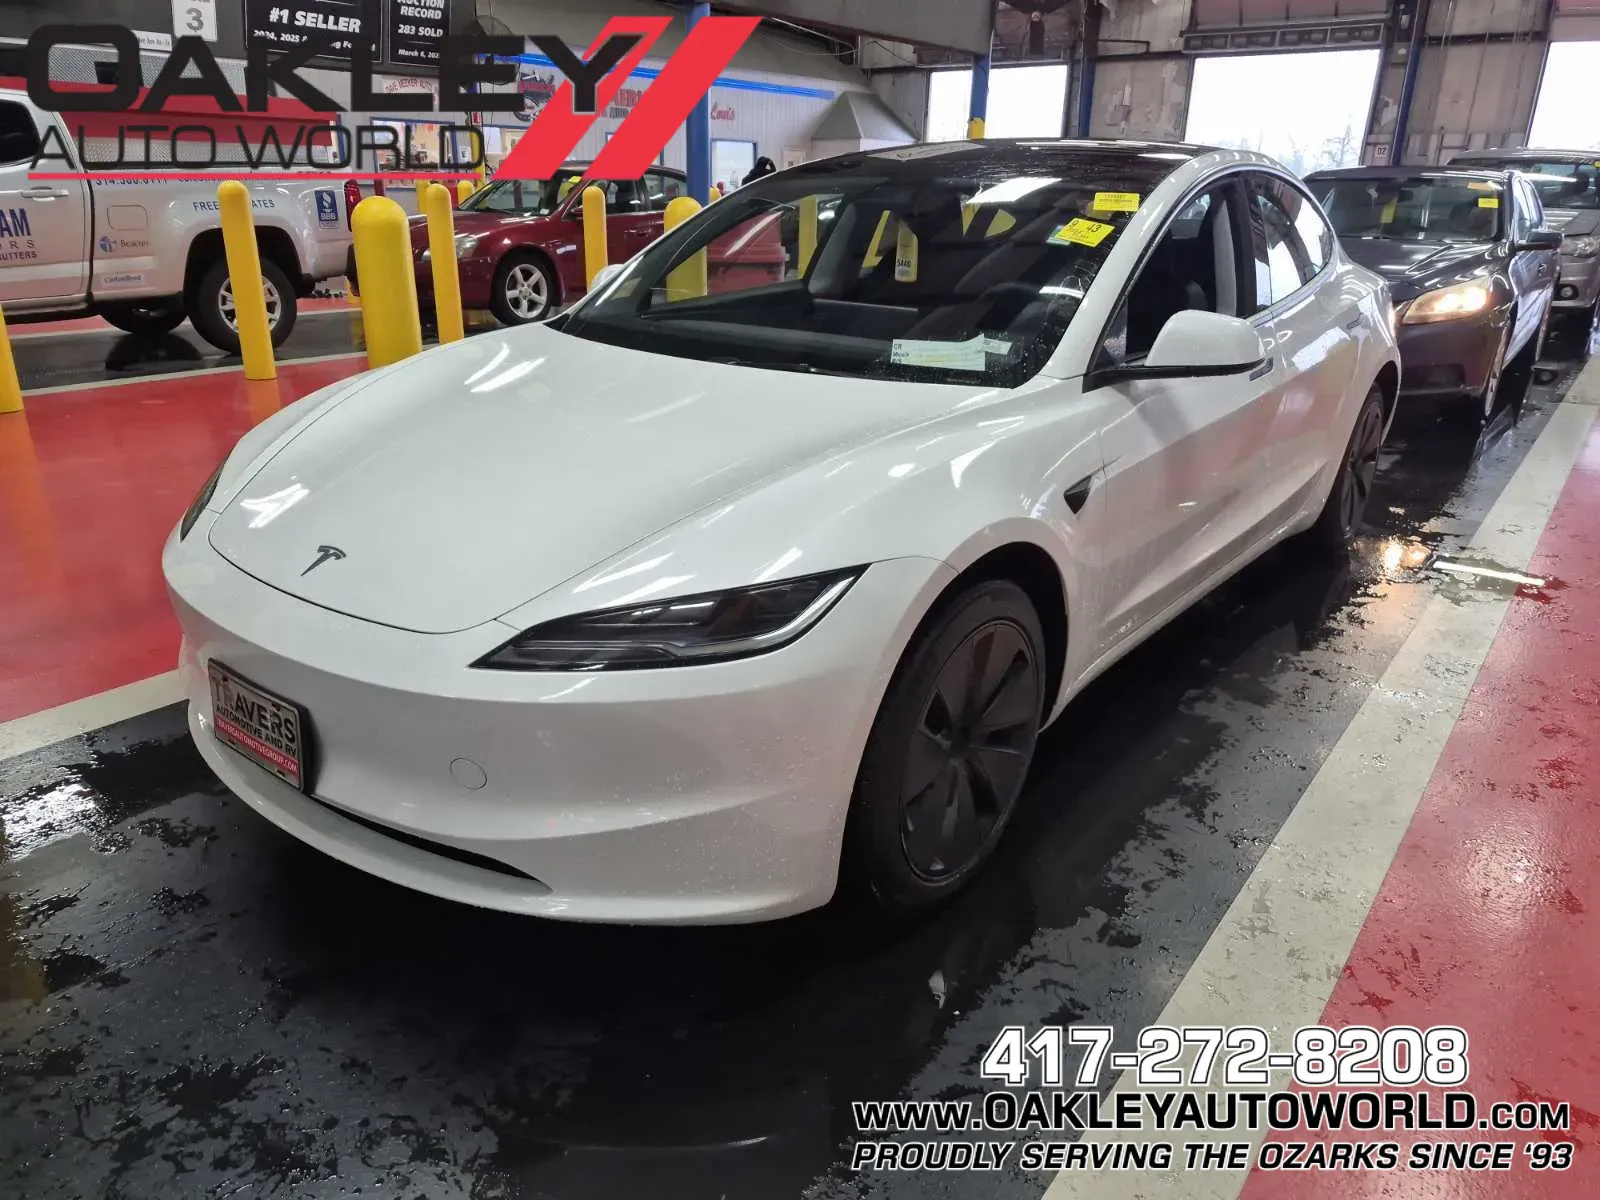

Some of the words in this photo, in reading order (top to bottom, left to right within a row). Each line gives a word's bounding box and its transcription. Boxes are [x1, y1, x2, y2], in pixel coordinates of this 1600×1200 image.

[185, 7, 204, 32] 3
[269, 7, 290, 24] #1
[294, 10, 361, 33] SELLER
[400, 5, 442, 20] RECORD
[397, 24, 416, 35] 283
[418, 26, 444, 38] SOLD
[216, 703, 264, 740] AUTOMOTIVE
